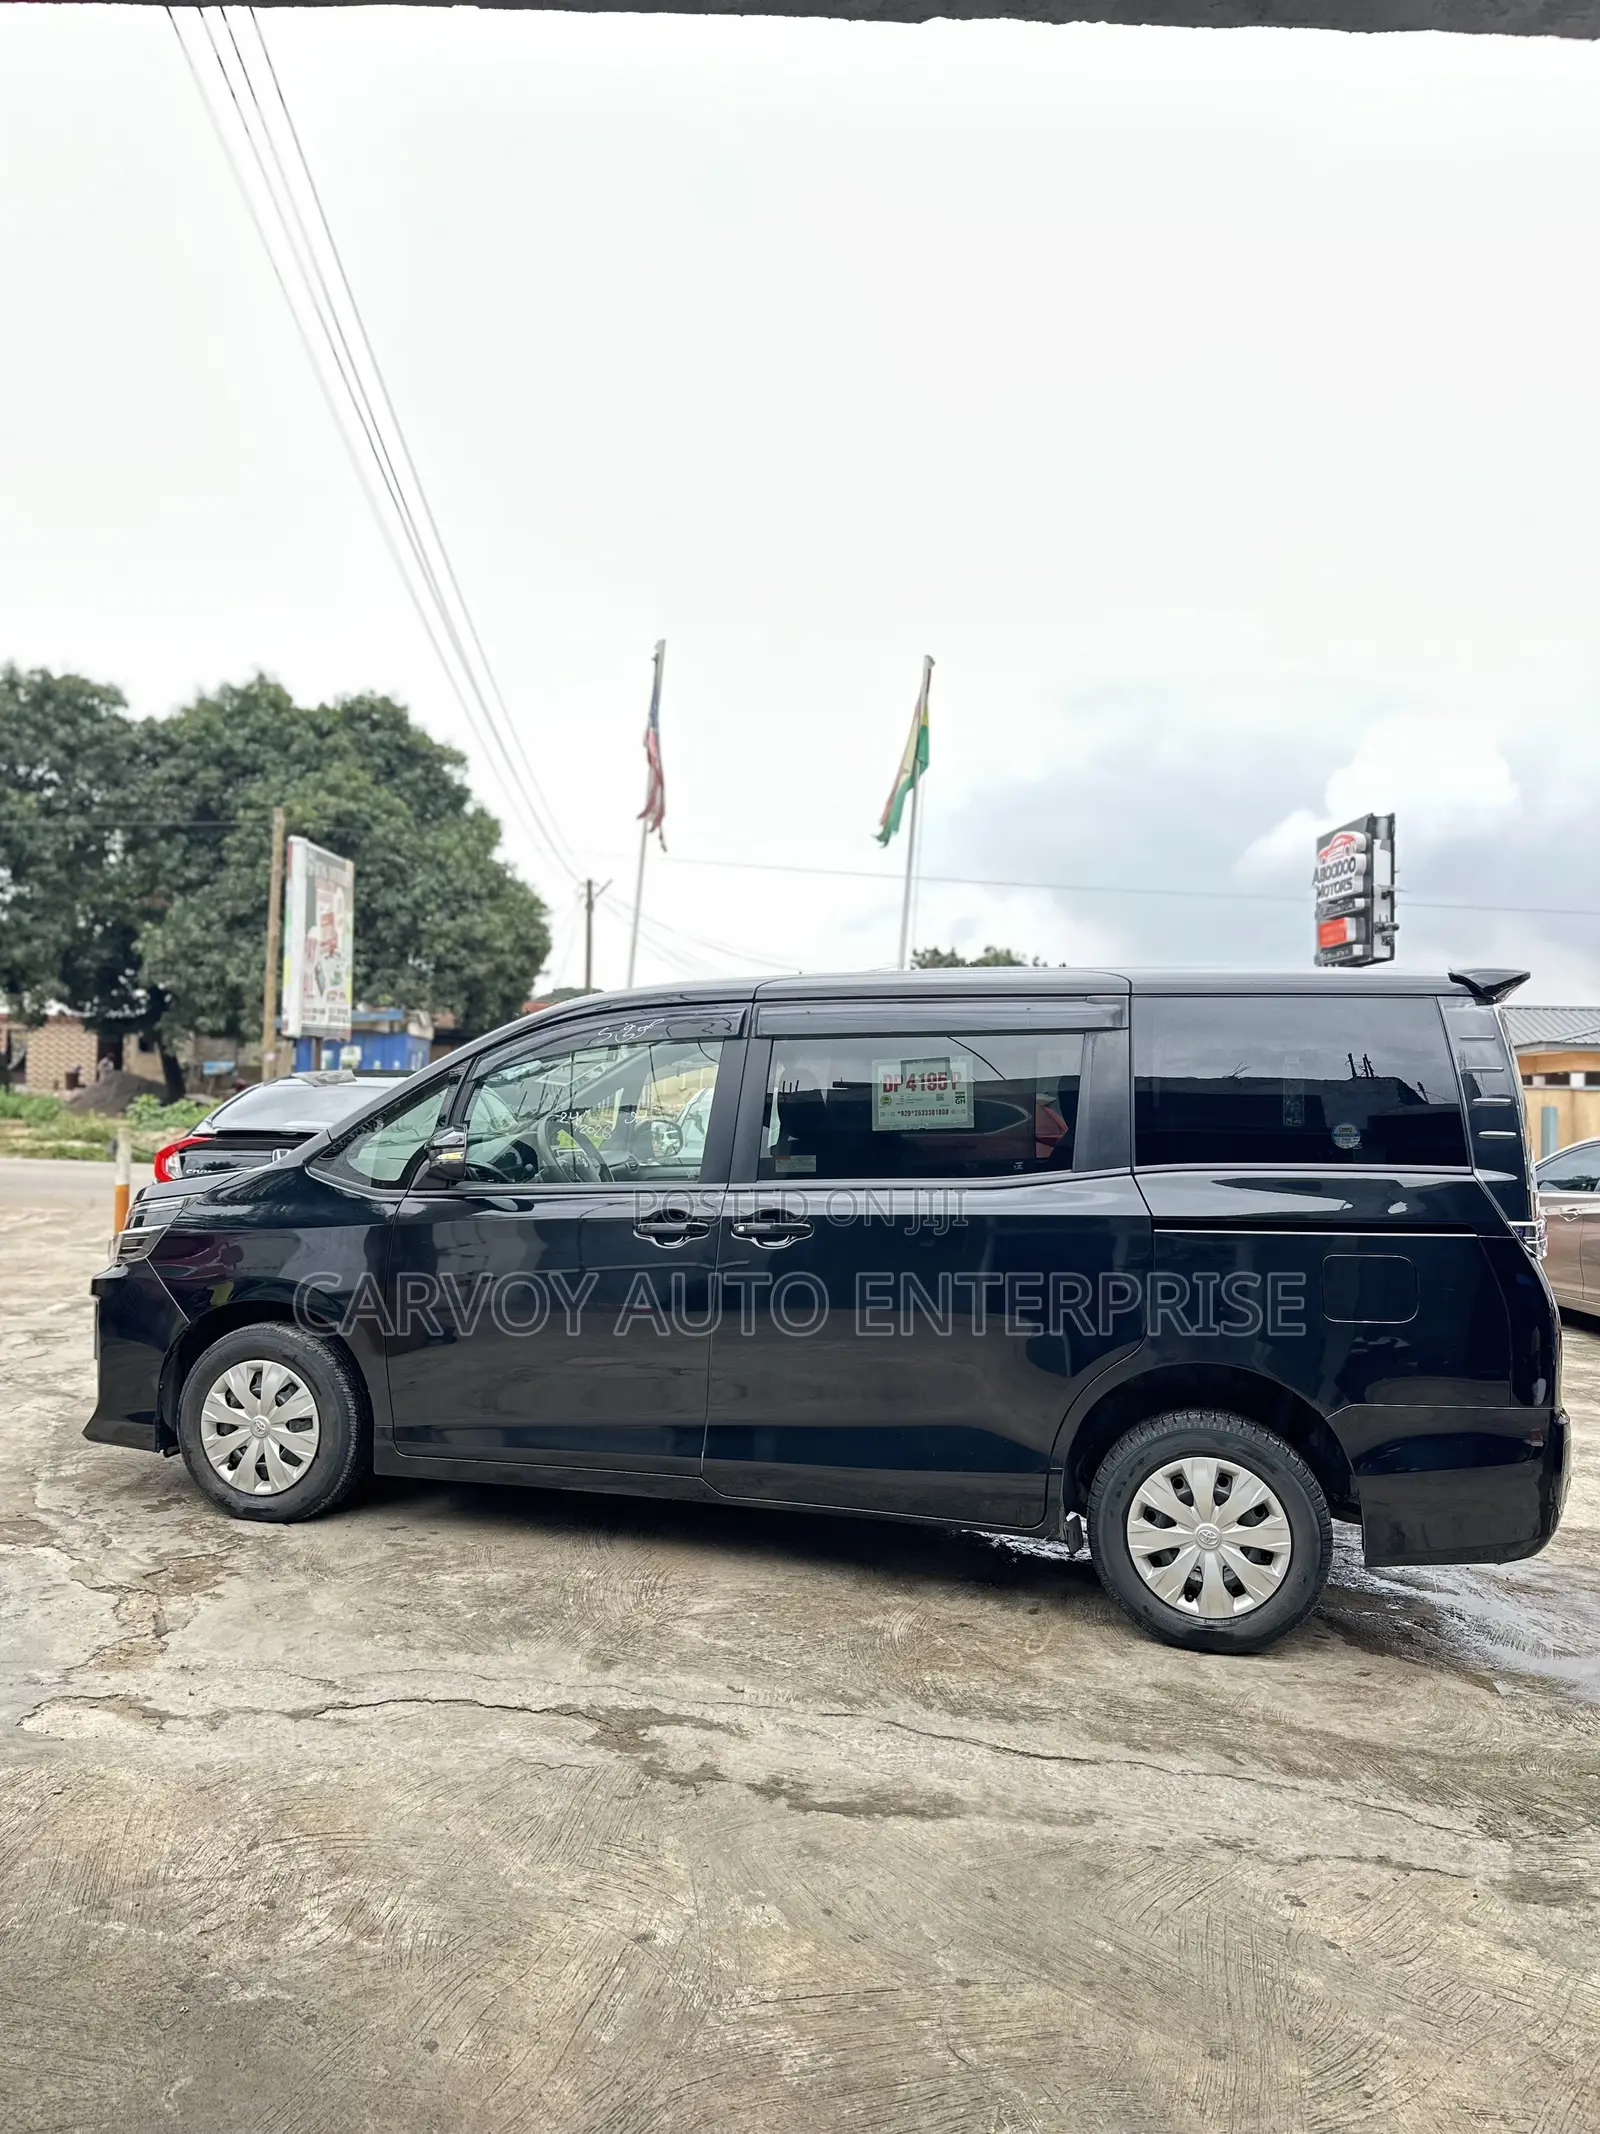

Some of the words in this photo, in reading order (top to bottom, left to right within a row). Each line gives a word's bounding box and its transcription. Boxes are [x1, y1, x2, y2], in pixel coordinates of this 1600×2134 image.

[1317, 877, 1353, 900] MOTORS
[883, 1074, 903, 1092] DP
[906, 1072, 947, 1091] 4195
